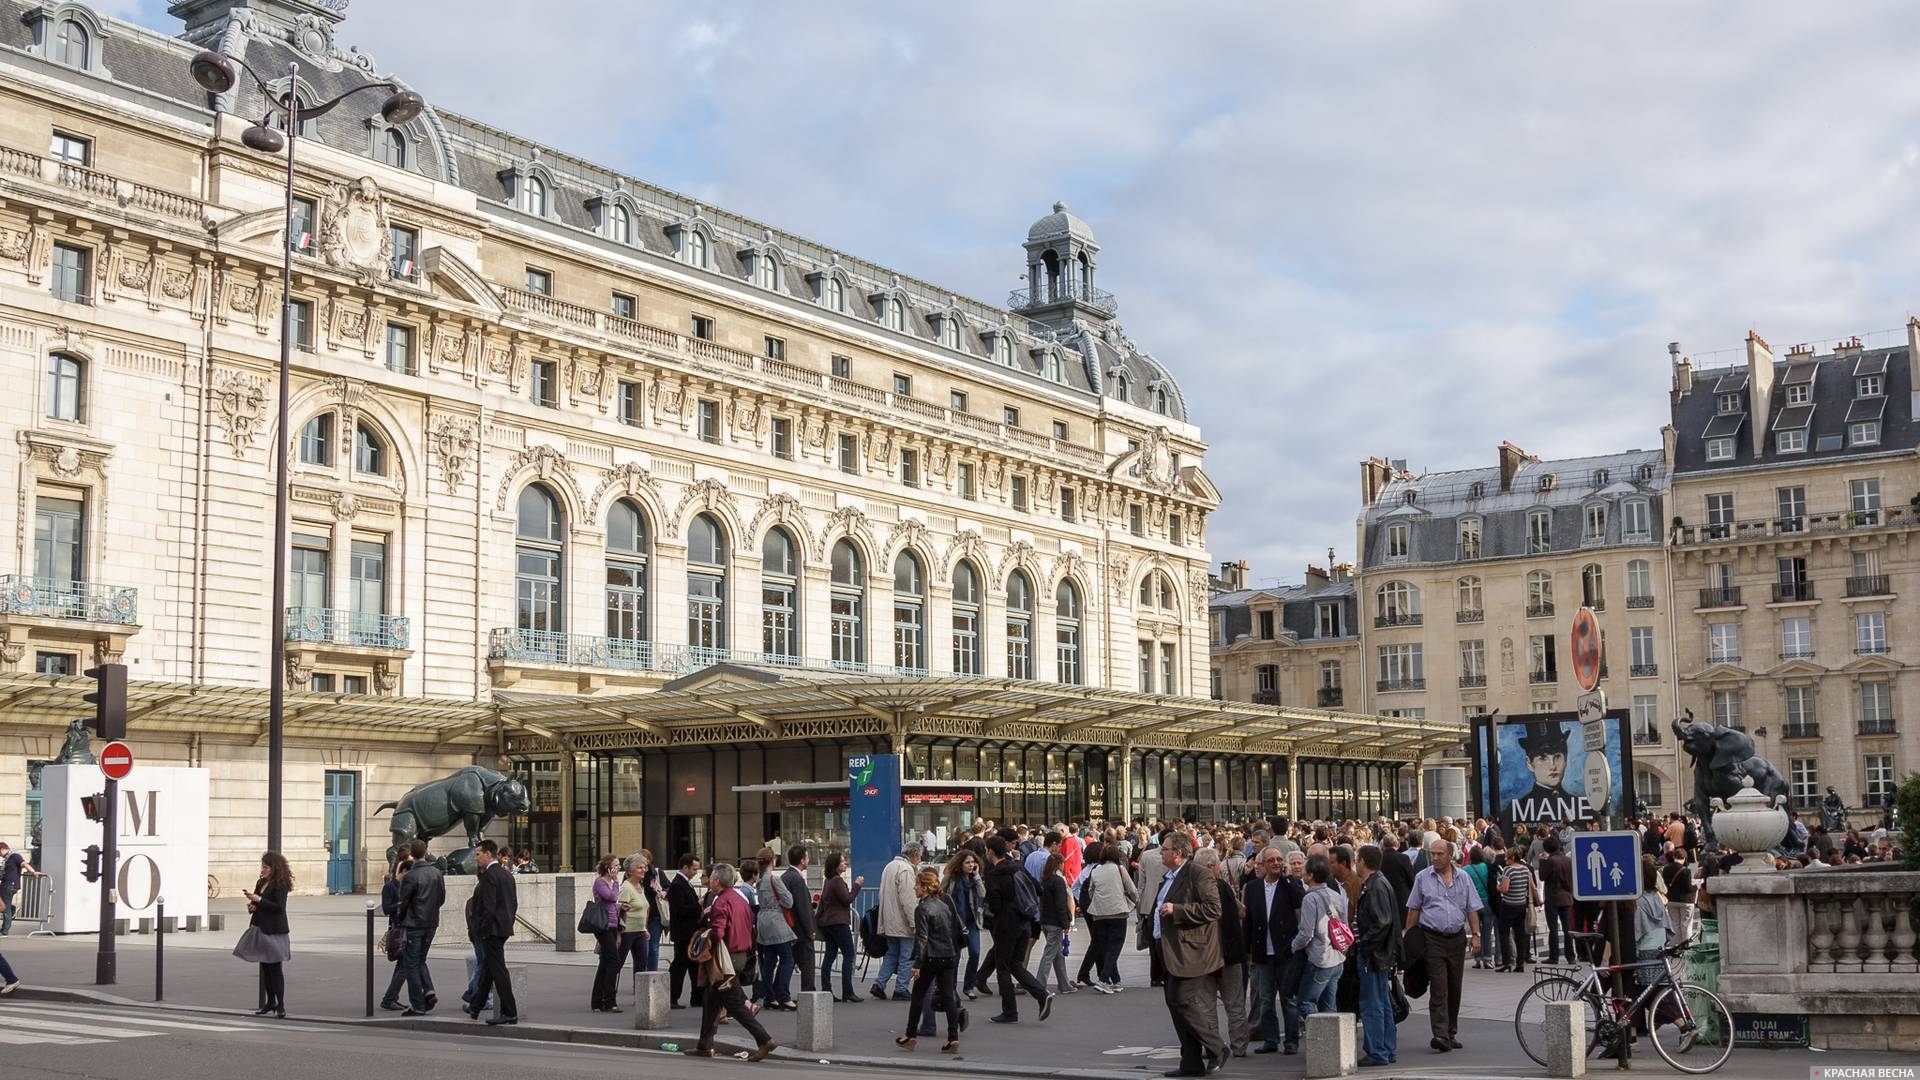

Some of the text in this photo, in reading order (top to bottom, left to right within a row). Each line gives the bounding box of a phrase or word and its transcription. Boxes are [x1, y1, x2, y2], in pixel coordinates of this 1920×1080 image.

[849, 758, 866, 768] RER
[864, 788, 878, 796] SNCF
[120, 790, 161, 836] M
[1511, 796, 1594, 822] MANE
[118, 854, 161, 910] O
[1752, 1020, 1777, 1030] QUAI
[1735, 1030, 1765, 1040] NATOLE
